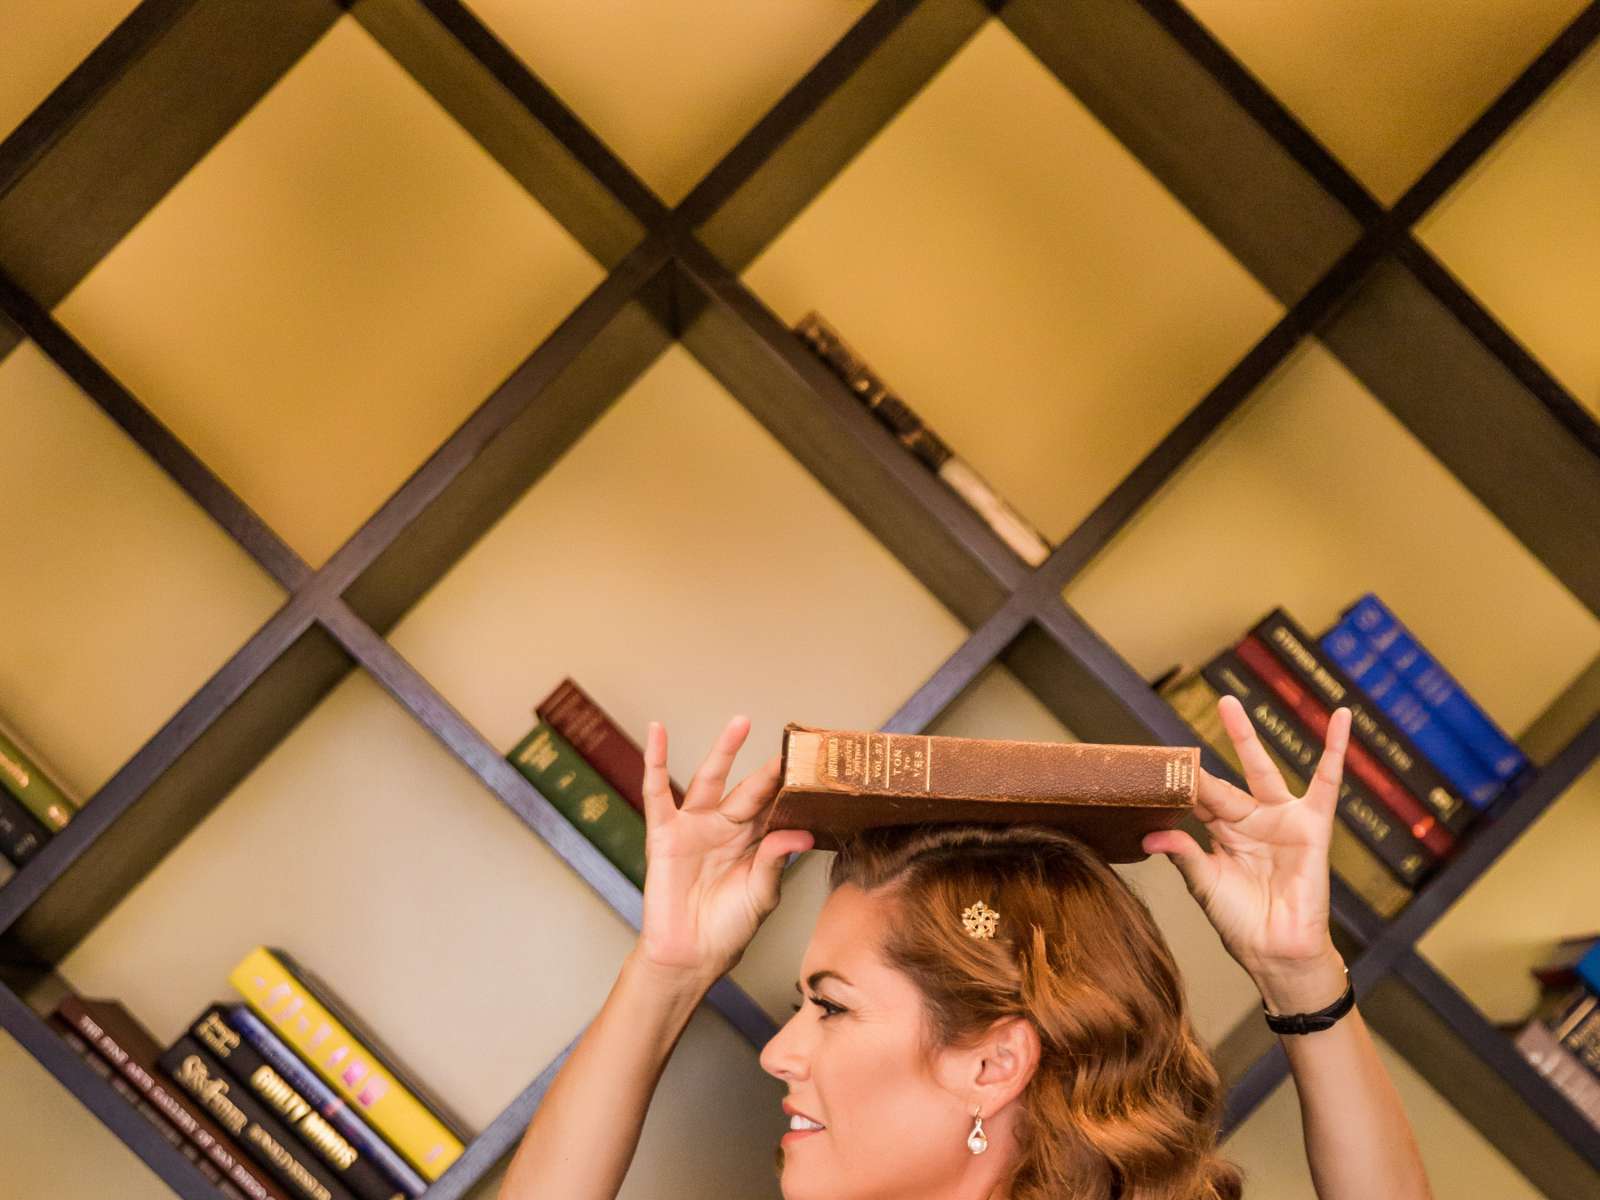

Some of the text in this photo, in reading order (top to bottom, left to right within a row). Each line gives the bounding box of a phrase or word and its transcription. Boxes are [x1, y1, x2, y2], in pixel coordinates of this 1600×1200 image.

[874, 743, 883, 755] 27
[893, 749, 903, 776] TON
[913, 751, 924, 777] VES
[121, 1058, 157, 1093] ARTS
[147, 1083, 200, 1136] GALLERY
[190, 1126, 216, 1152] OF
[208, 1142, 238, 1172] SAN
[248, 1061, 312, 1126] GUILTY
[295, 1108, 361, 1174] MINDS
